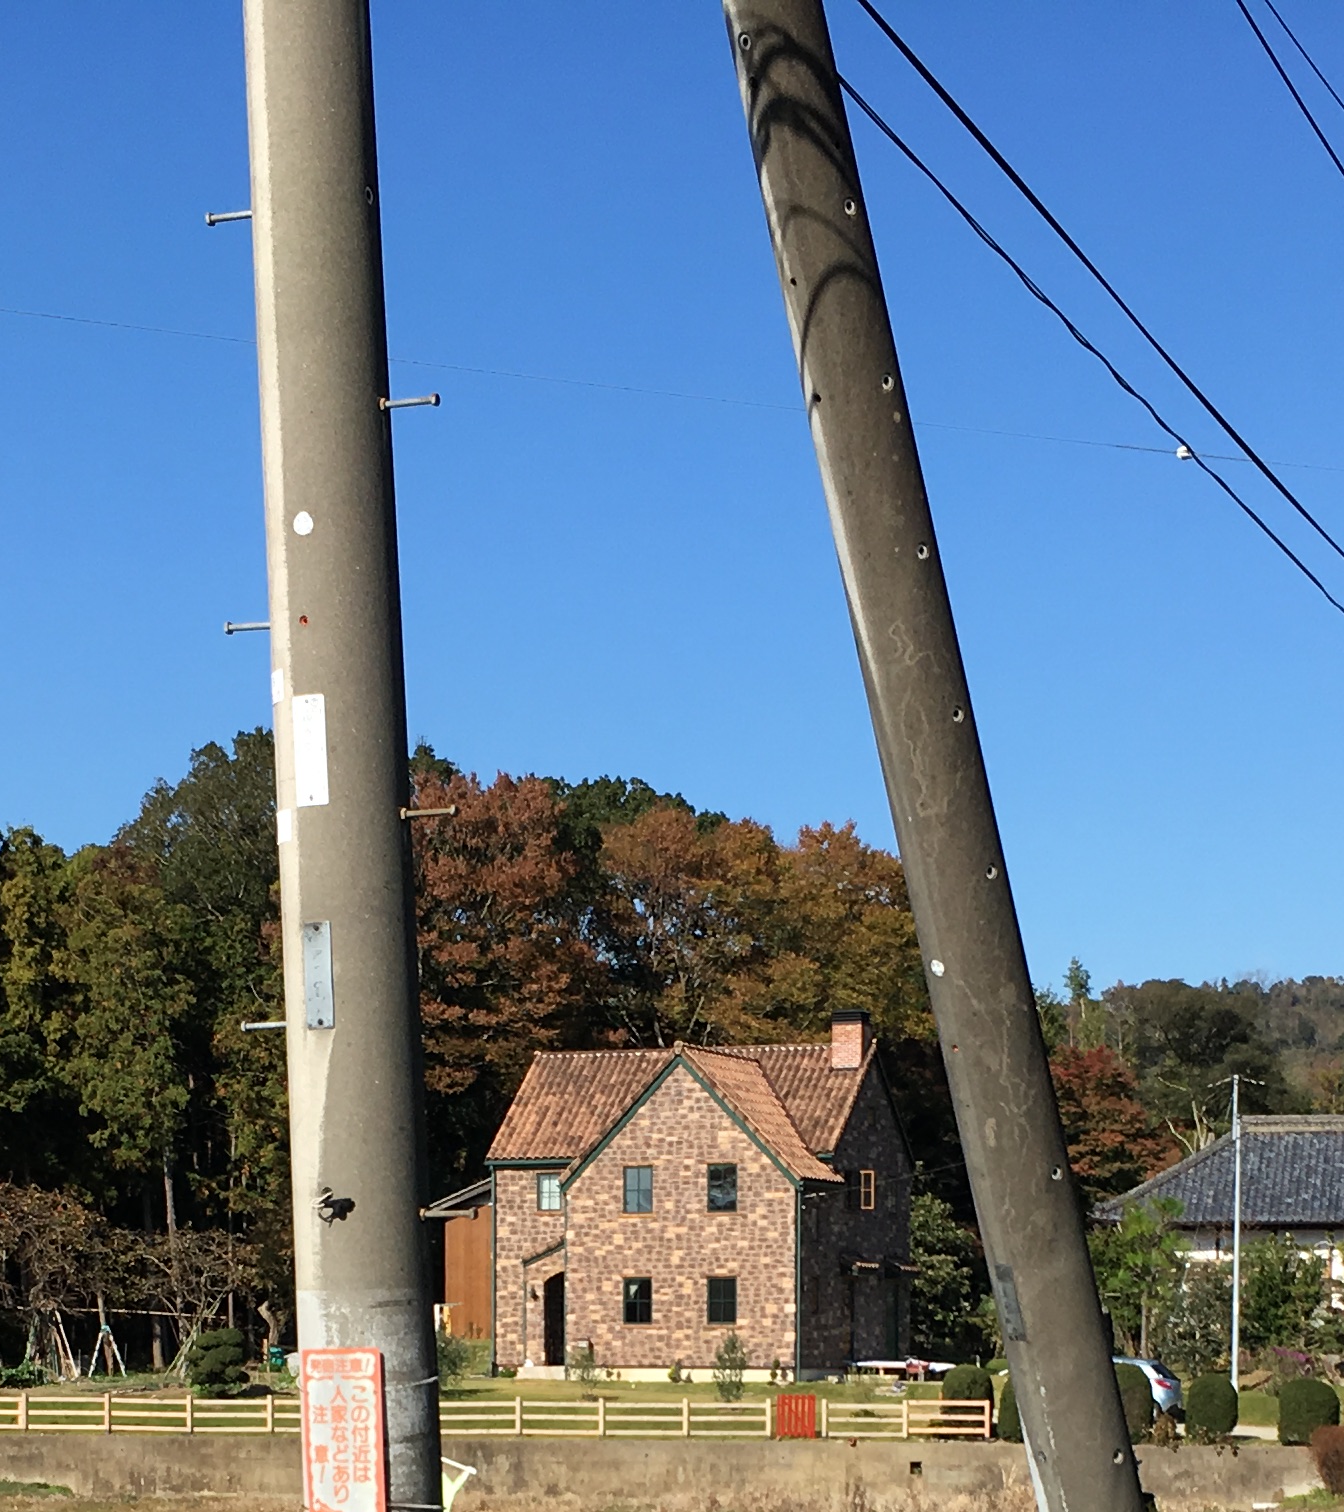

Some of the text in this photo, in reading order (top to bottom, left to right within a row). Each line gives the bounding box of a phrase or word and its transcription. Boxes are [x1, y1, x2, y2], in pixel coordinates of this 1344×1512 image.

[330, 1385, 351, 1504] 人家などあり
[351, 1386, 371, 1484] この付近は
